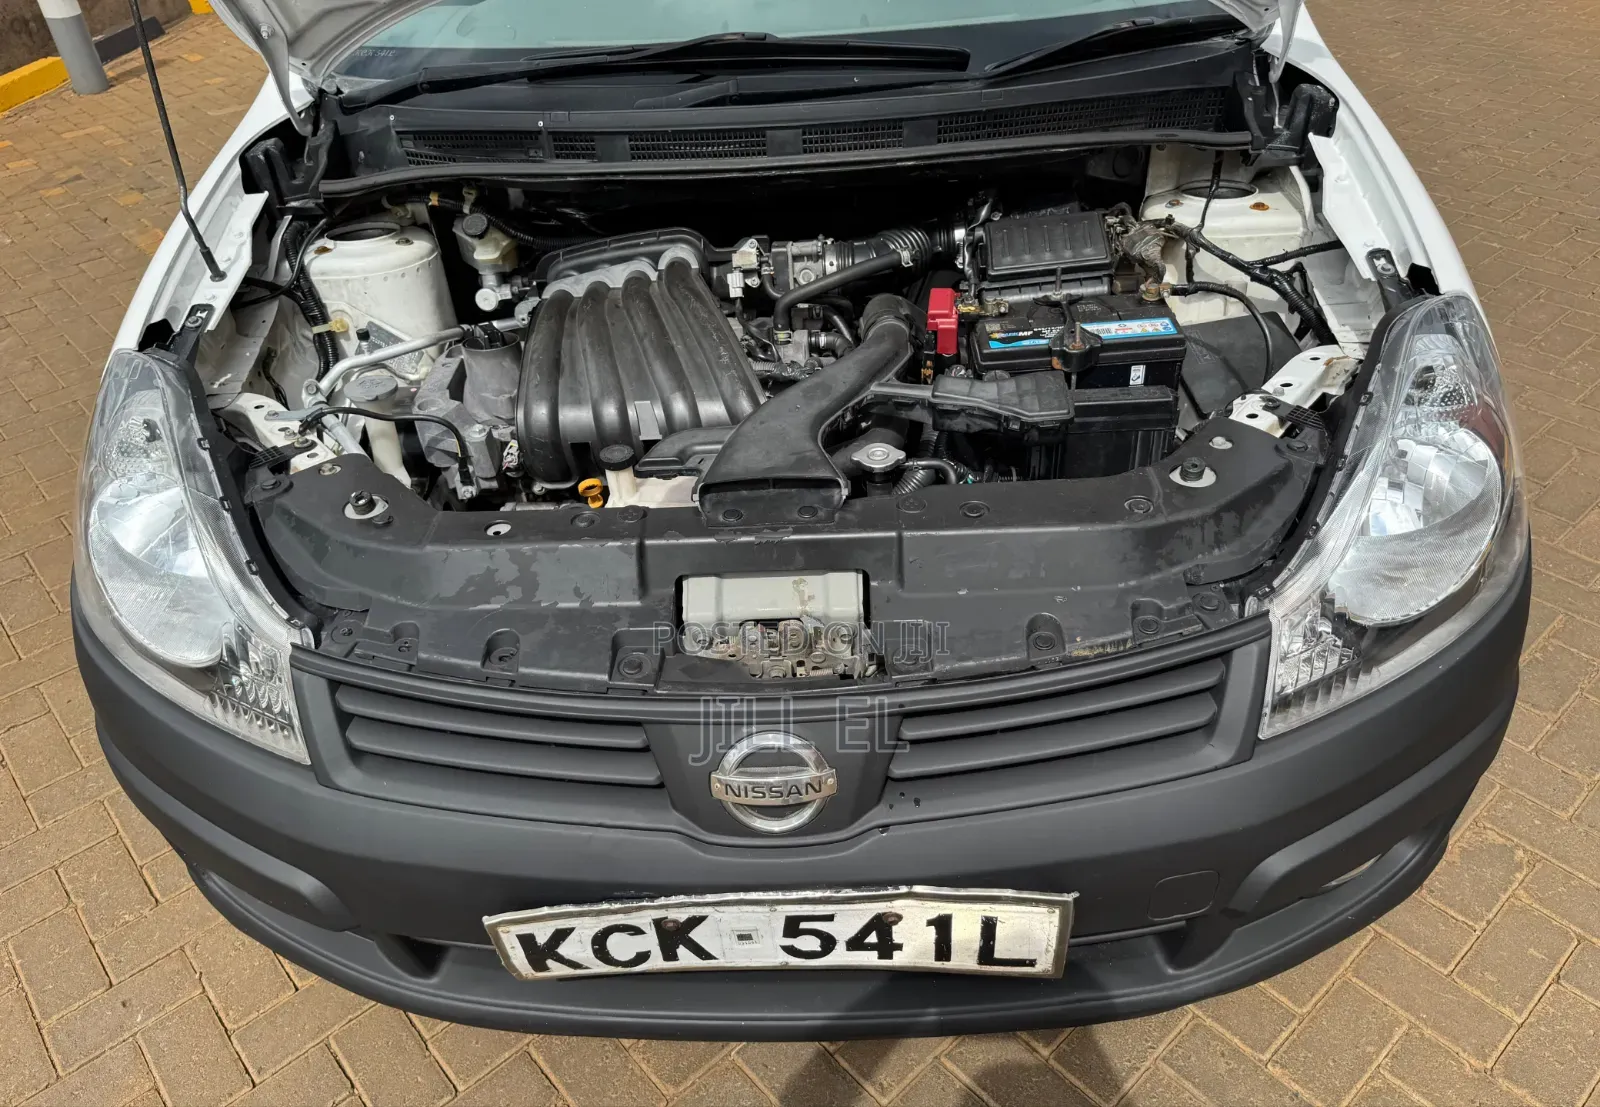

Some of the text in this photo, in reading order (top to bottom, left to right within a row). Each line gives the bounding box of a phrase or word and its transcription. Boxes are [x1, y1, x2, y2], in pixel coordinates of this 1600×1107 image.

[724, 779, 823, 799] NISSAN
[515, 911, 1037, 972] KCK 541L
